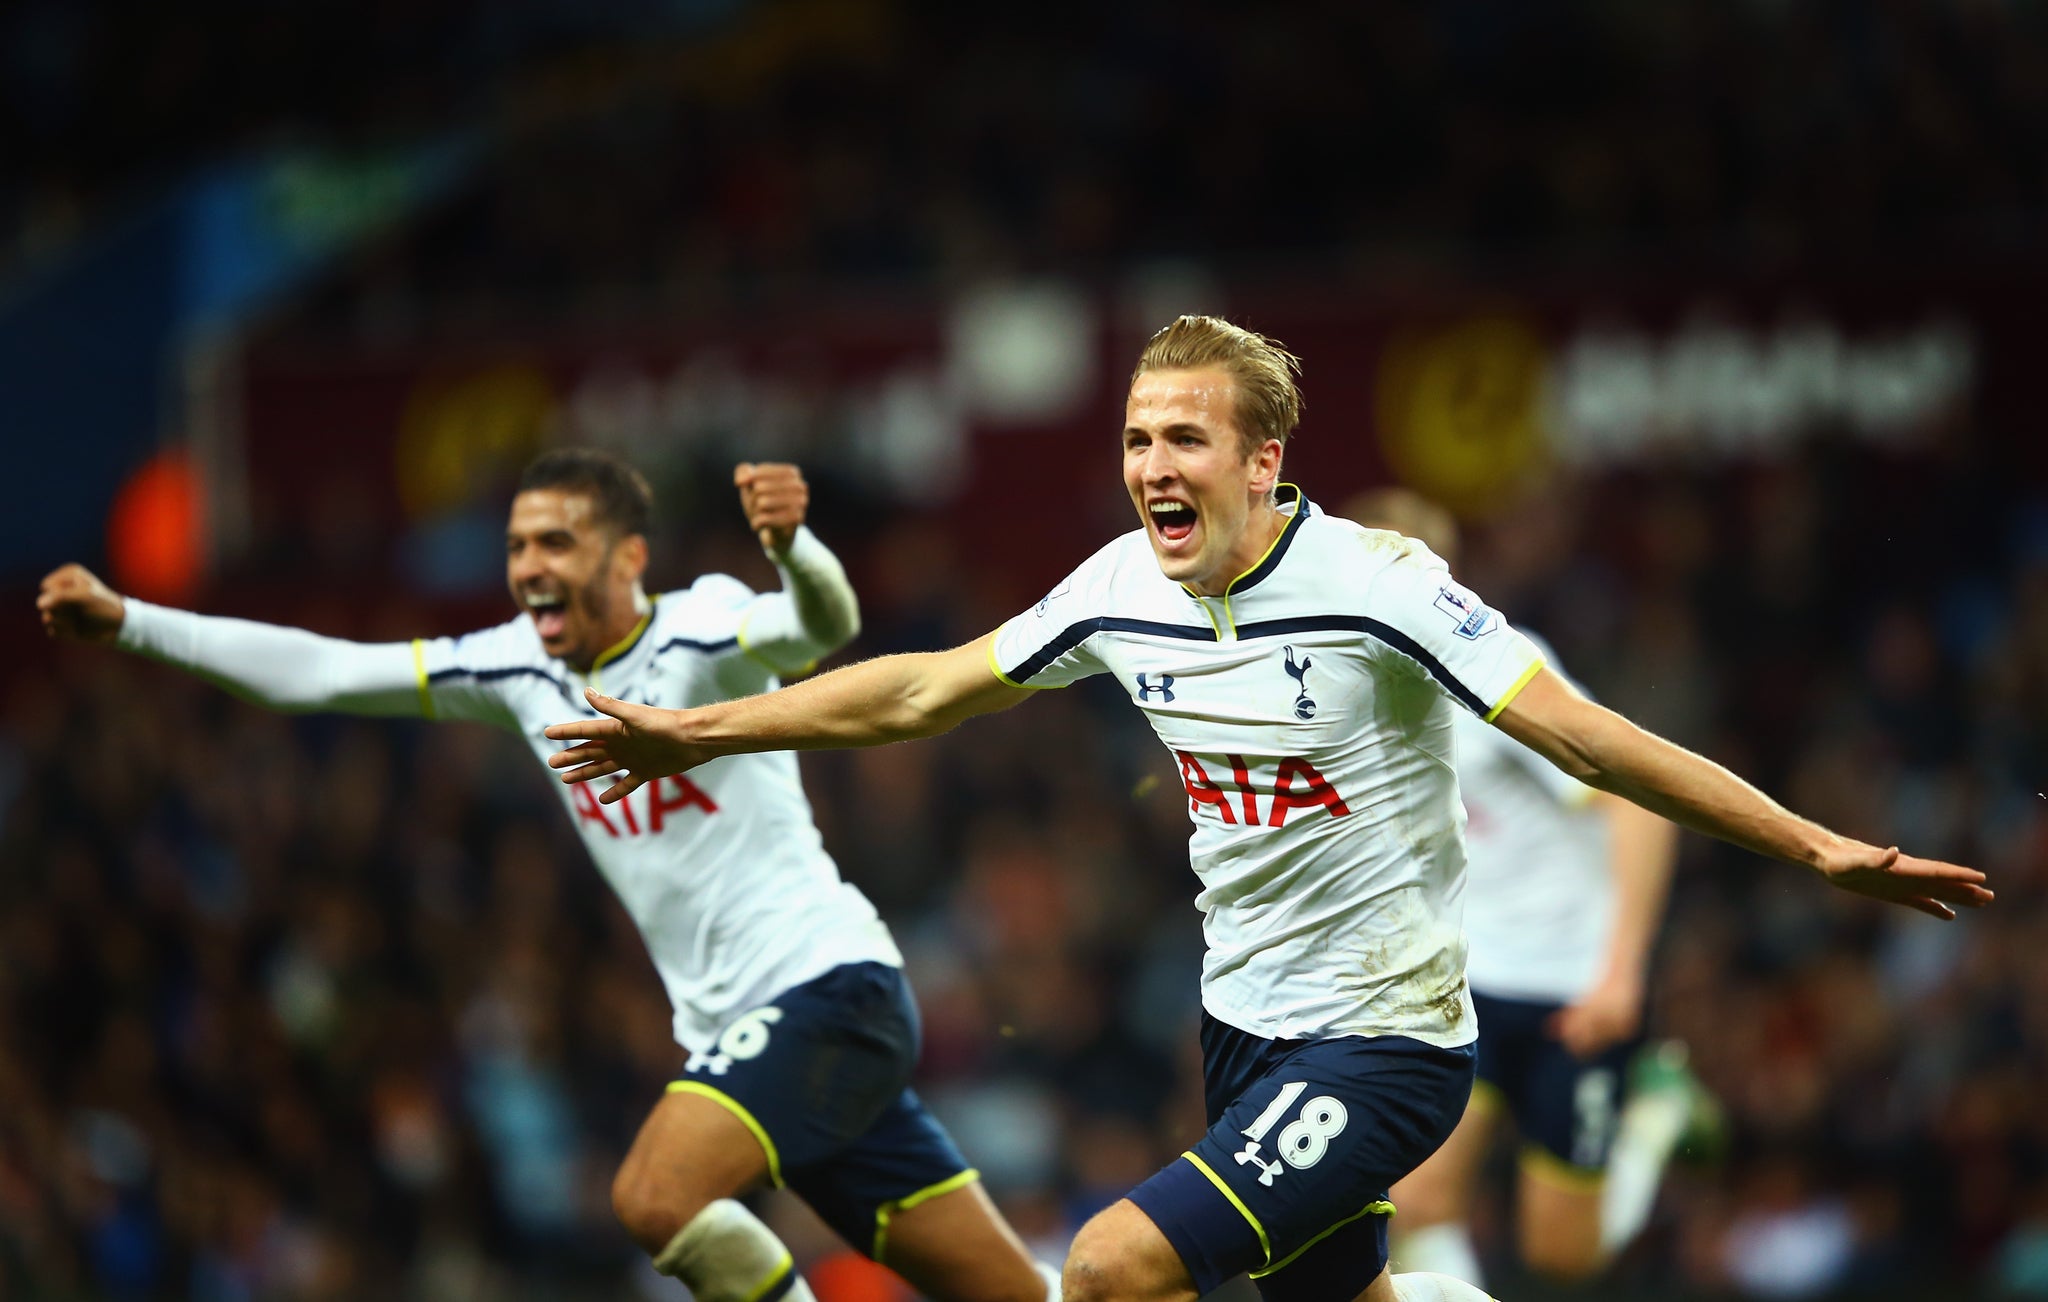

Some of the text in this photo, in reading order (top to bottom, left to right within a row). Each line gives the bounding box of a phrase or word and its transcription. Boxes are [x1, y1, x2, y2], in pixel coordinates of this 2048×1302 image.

[570, 772, 719, 838] AIA
[1176, 750, 1351, 828] AIA
[1241, 1081, 1348, 1170] 18
